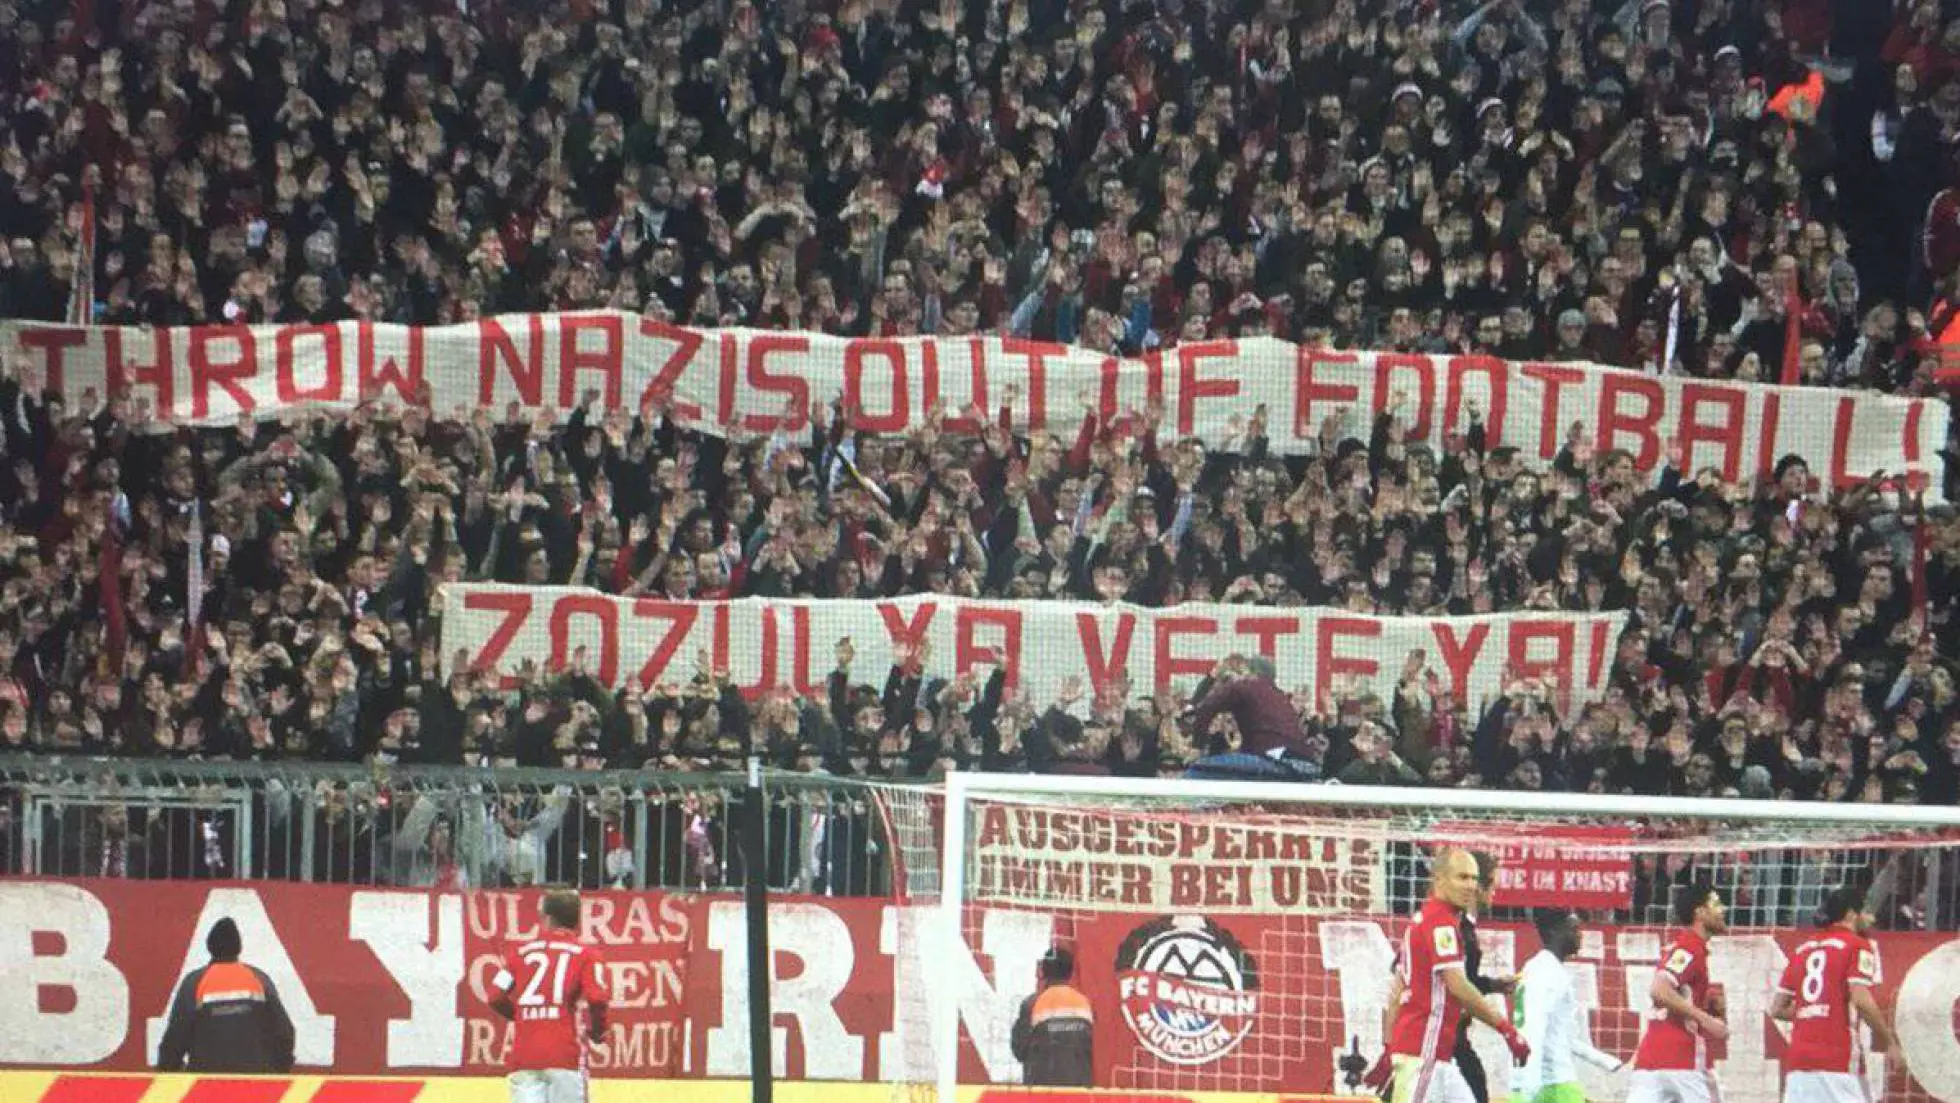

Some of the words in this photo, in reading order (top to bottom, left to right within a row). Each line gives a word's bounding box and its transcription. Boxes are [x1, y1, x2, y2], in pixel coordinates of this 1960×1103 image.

[20, 319, 425, 421] THROW
[480, 314, 809, 432] NAZIS
[844, 335, 1068, 434] OUT
[1101, 340, 1240, 437] OF
[1293, 352, 1930, 491] FOOTBALL!
[1076, 612, 1382, 713] VETE
[978, 855, 1152, 904] IMMER
[1171, 864, 1252, 907] BEI
[1271, 865, 1370, 910] UNS
[1562, 871, 1629, 893] KNAST
[468, 891, 689, 945] ULRAS
[518, 952, 571, 1005] 21
[1120, 976, 1149, 999] FC
[1157, 979, 1257, 1014] BAYERN
[1803, 950, 1826, 1003] 8
